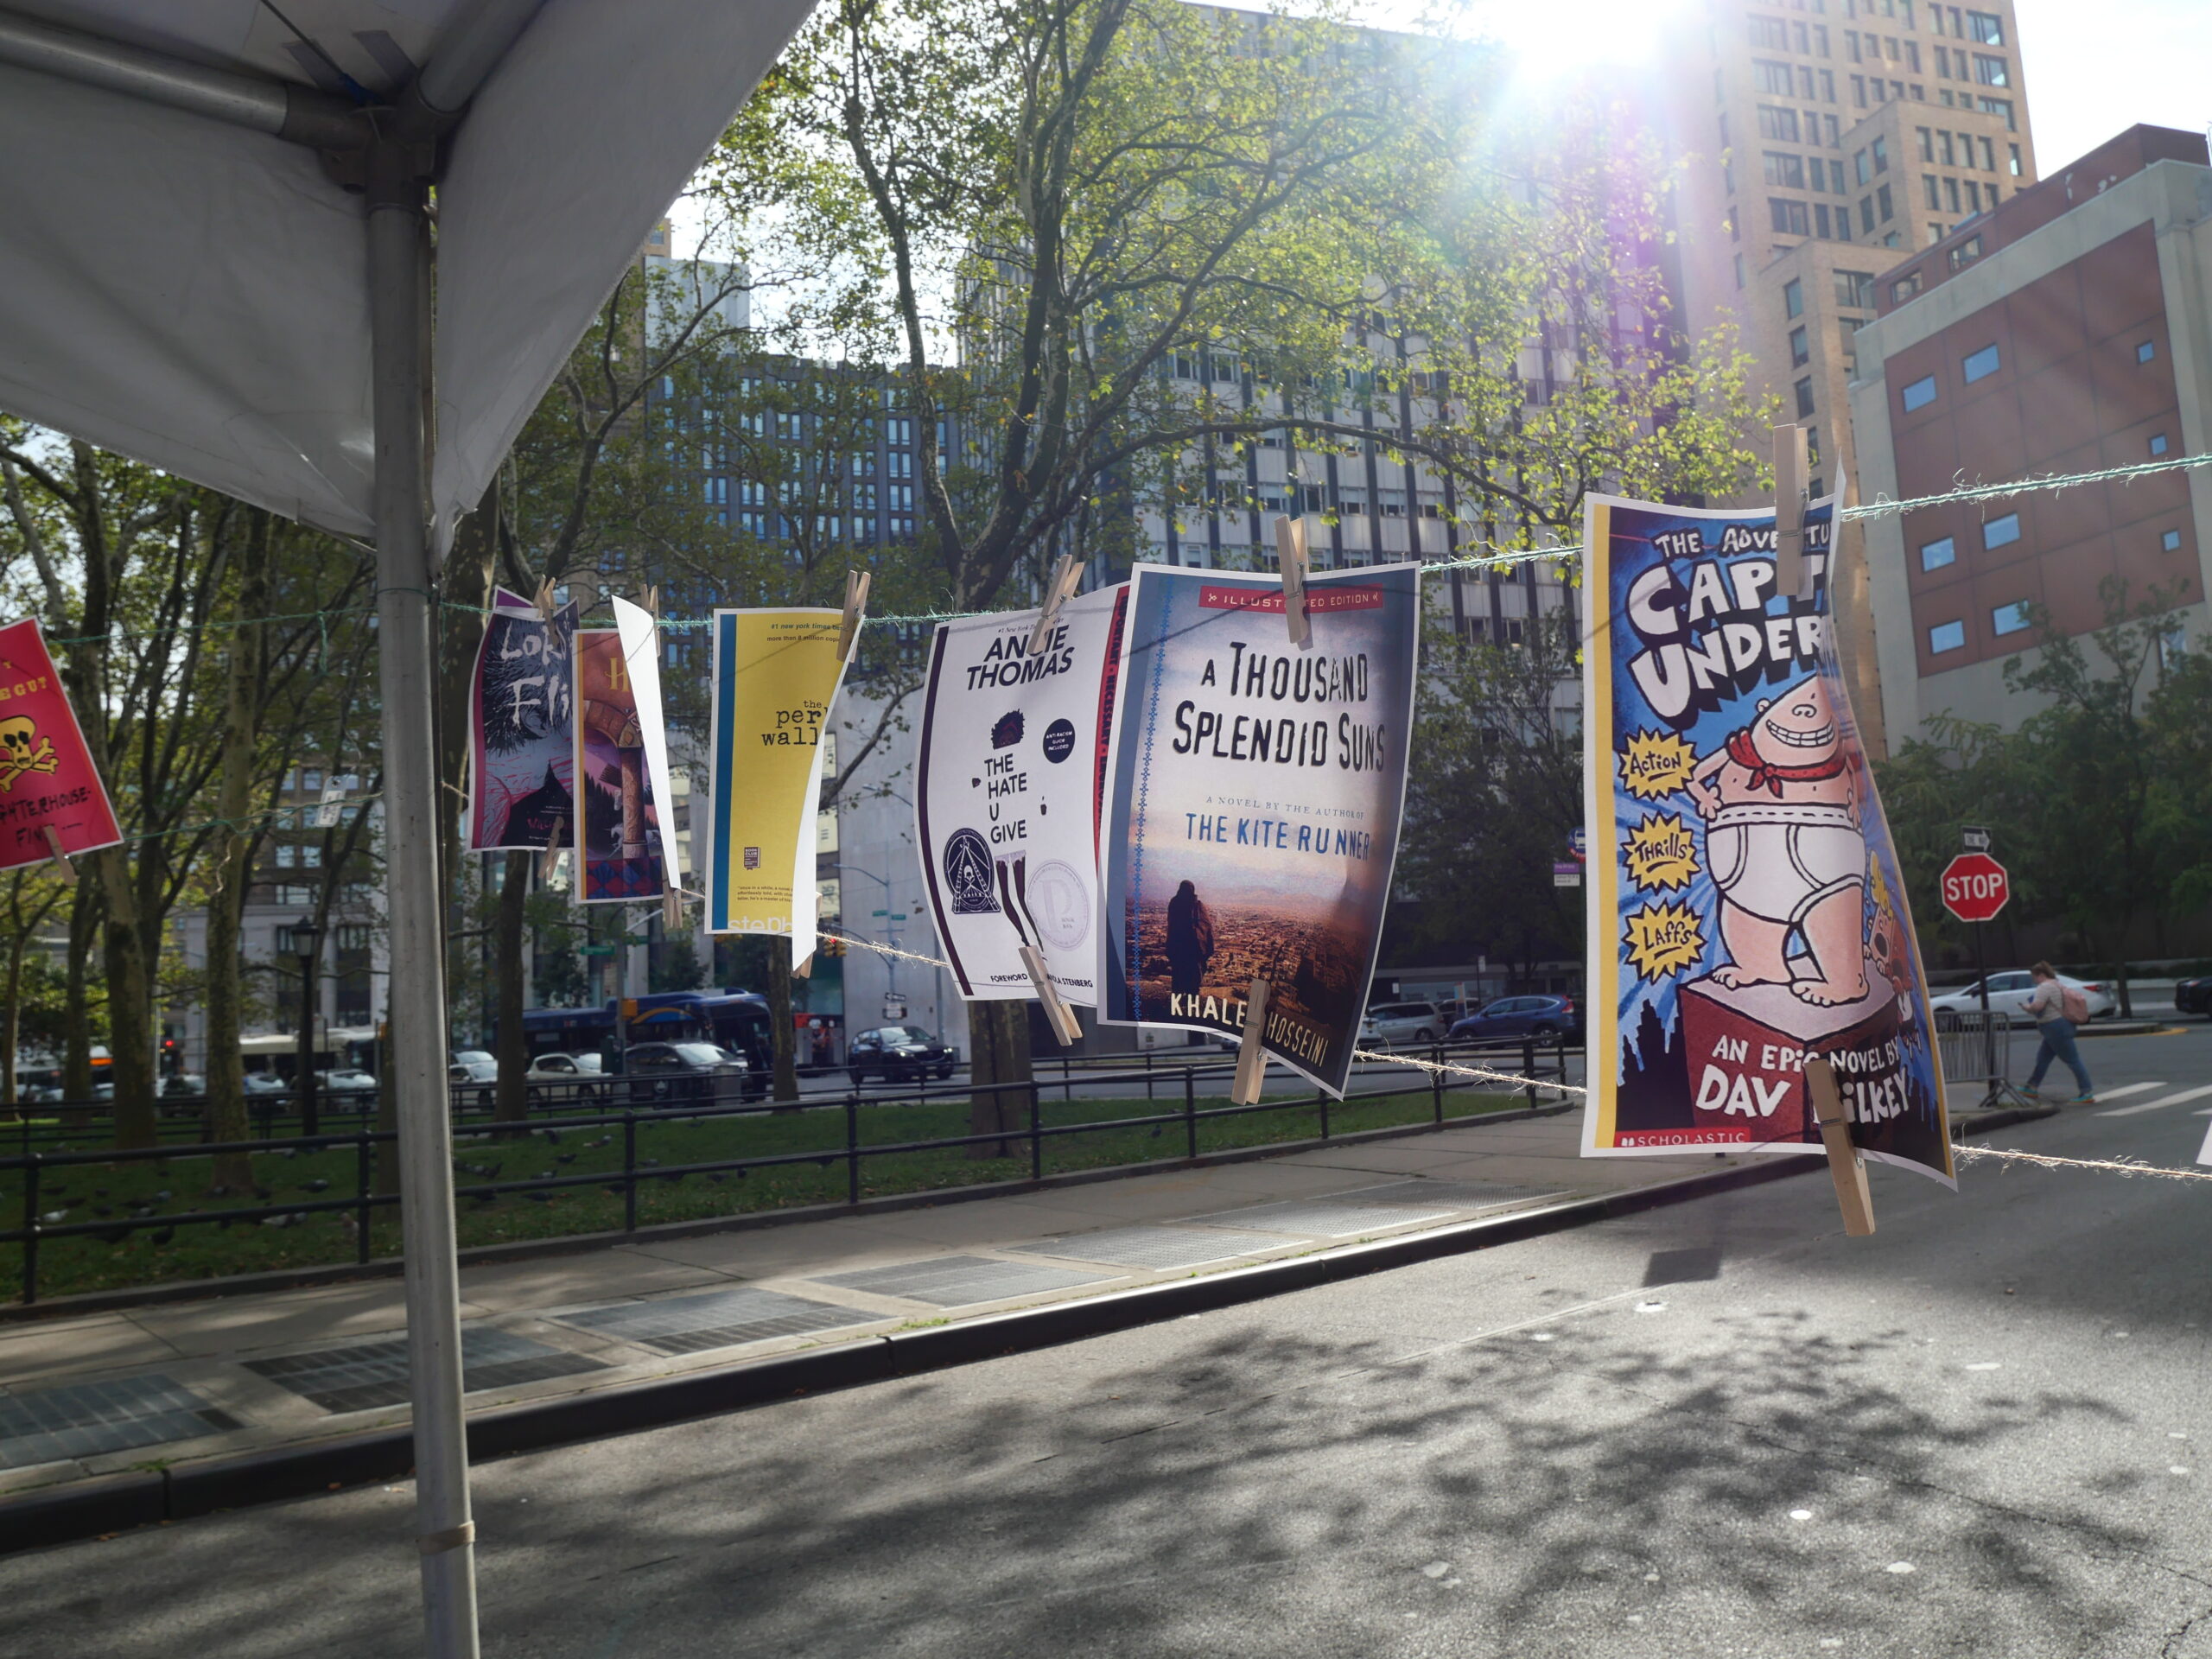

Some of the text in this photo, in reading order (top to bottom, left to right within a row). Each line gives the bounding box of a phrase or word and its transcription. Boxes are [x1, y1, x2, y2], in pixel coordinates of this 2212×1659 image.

[1655, 524, 1829, 557] THE ADVETU
[1330, 594, 1370, 606] EDITION
[983, 625, 1070, 662] ANIE
[967, 646, 1075, 690] THOMAS
[1201, 641, 1368, 702] A THOUSAND
[803, 700, 822, 709] the
[1173, 700, 1385, 772] SPLENDID SUNS
[984, 753, 1014, 777] THE
[988, 772, 1027, 799] HATE
[989, 803, 999, 821] U
[1218, 797, 1261, 808] NOVEL
[1265, 802, 1280, 810] BY
[1286, 804, 1311, 814] THE
[1315, 808, 1355, 819] AUTHOR
[990, 819, 1027, 844] GIVE
[1185, 813, 1370, 861] THE KITE RUNNER
[1946, 873, 2003, 901] STOP
[990, 973, 1027, 982] FOREWORD
[1063, 977, 1093, 988] STENBERG
[1171, 993, 1329, 1068] KHALE HOSSEINI
[1713, 1035, 1749, 1064] AN
[1830, 1045, 1885, 1074] NOVEL
[1886, 1034, 1900, 1069] BY
[1695, 1064, 1792, 1118] DAV
[1638, 1132, 1746, 1147] SCHOLASTIC
